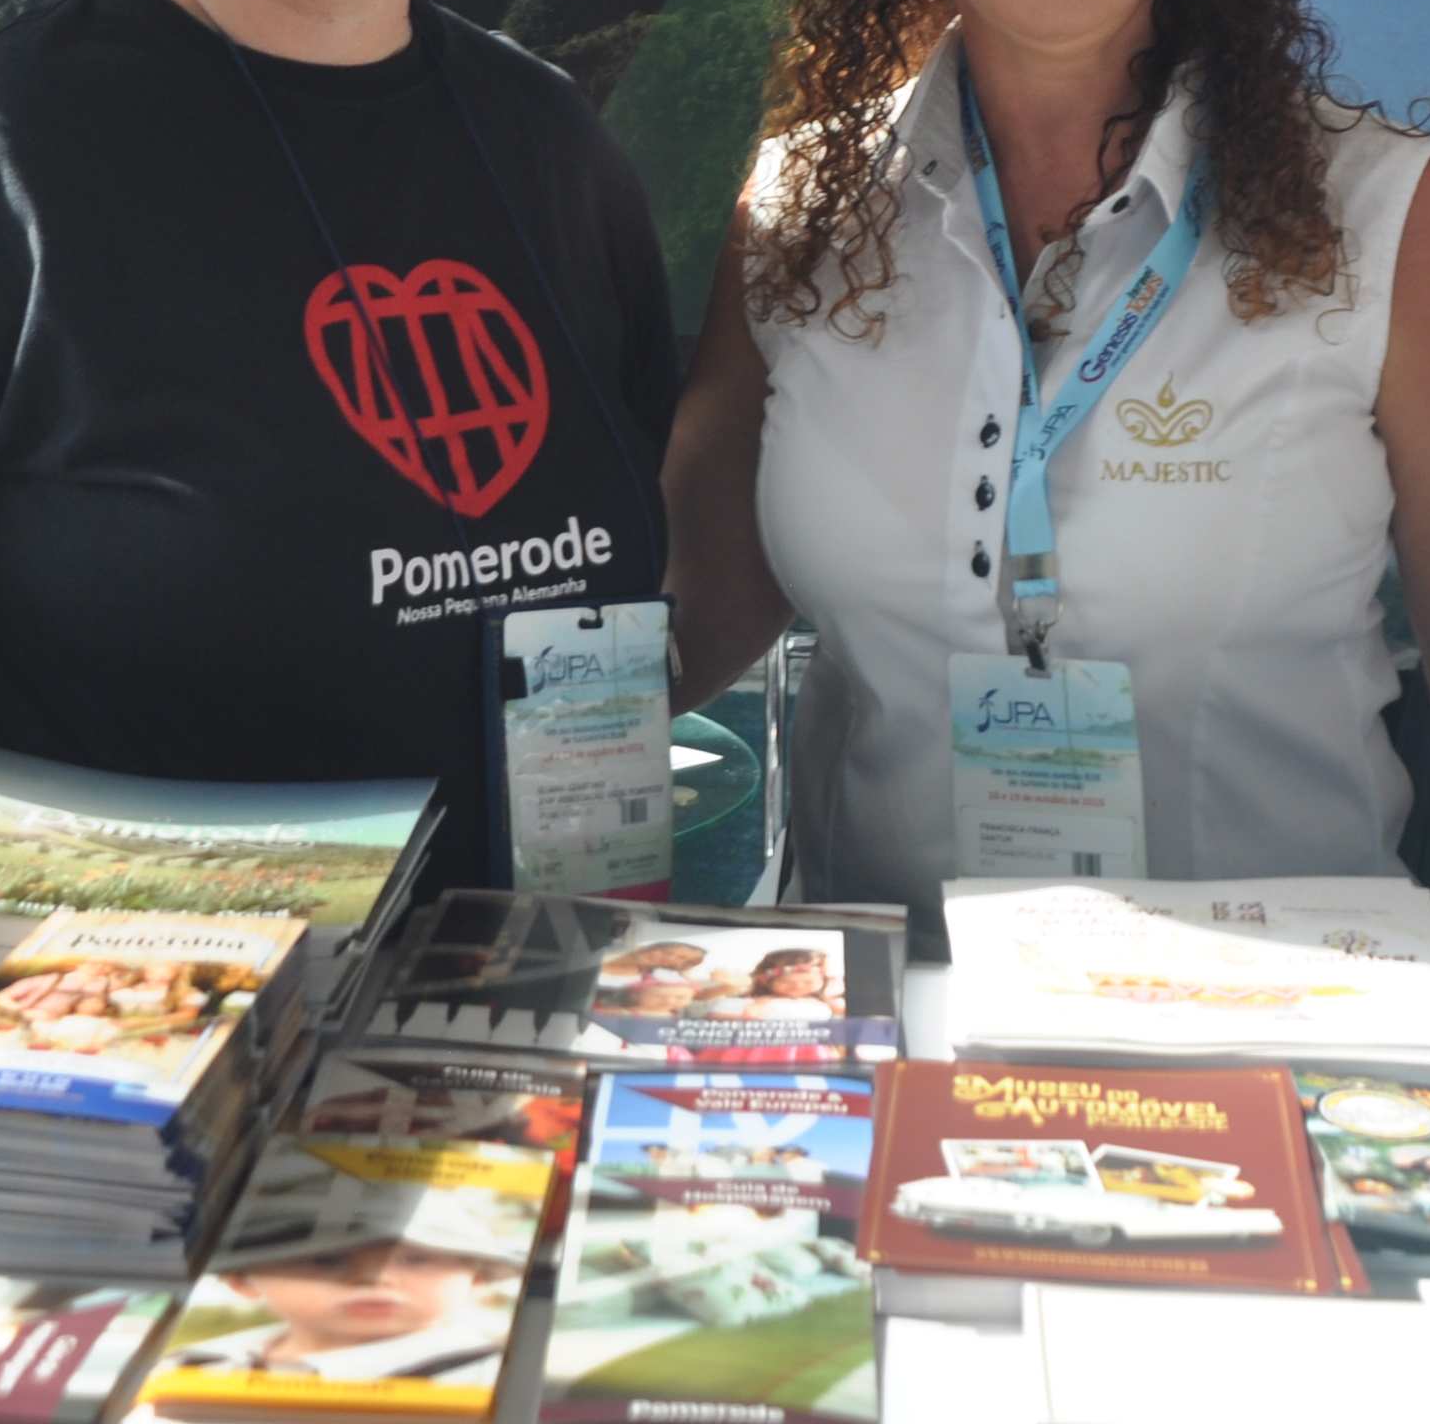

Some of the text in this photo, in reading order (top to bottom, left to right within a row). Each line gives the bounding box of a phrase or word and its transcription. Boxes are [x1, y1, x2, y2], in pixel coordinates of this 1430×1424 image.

[1079, 272, 1165, 384] Genesis Tours
[1100, 459, 1233, 484] MAJESTIC
[370, 515, 613, 606] Pomerode
[397, 602, 442, 626] Nossa
[511, 577, 587, 604] Alemanha
[954, 1075, 1140, 1103] MUSEU DO
[627, 1398, 787, 1424] Pomerode
